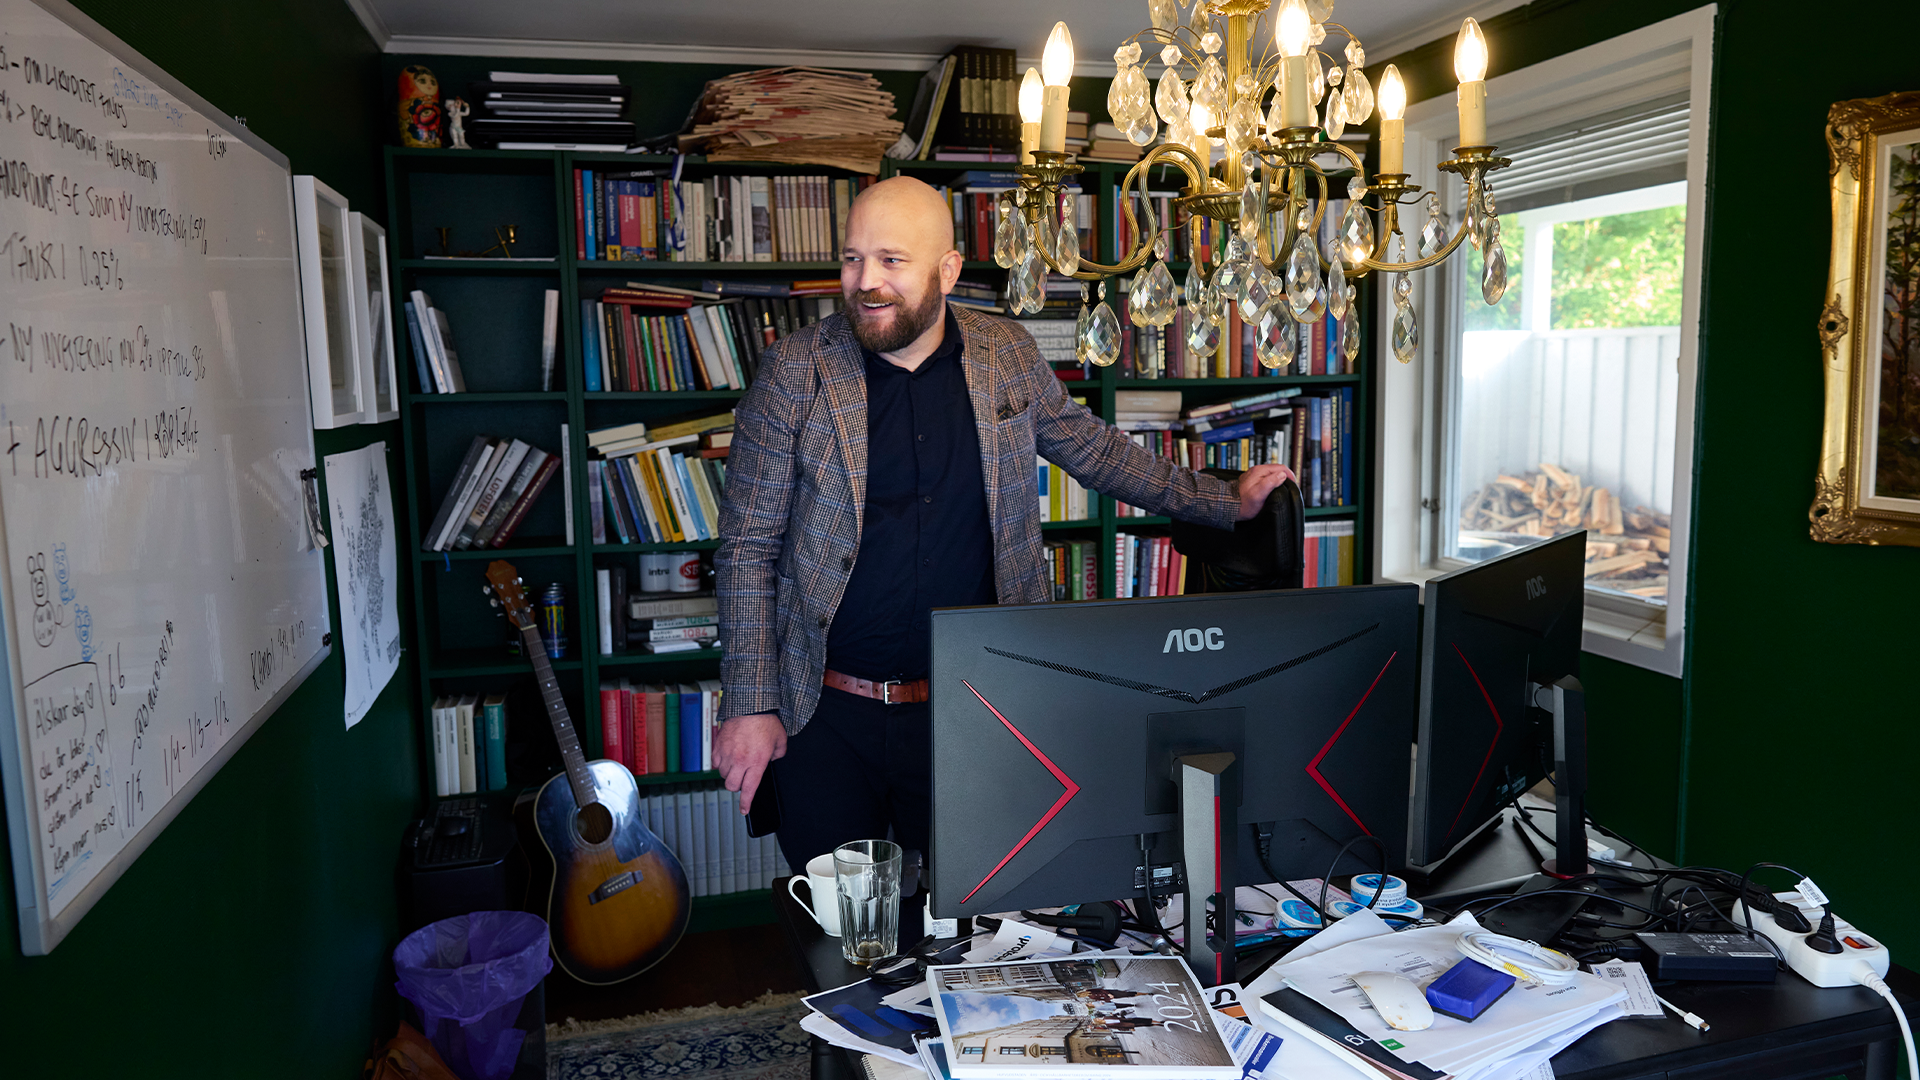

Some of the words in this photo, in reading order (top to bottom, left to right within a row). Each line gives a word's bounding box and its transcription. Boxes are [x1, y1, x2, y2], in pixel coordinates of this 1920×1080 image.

[474, 476, 503, 519] LOFOTEN
[1525, 574, 1547, 601] AOC
[682, 627, 708, 638] 1Q84
[1163, 626, 1225, 654] AOC
[1156, 981, 1202, 1034] 2024
